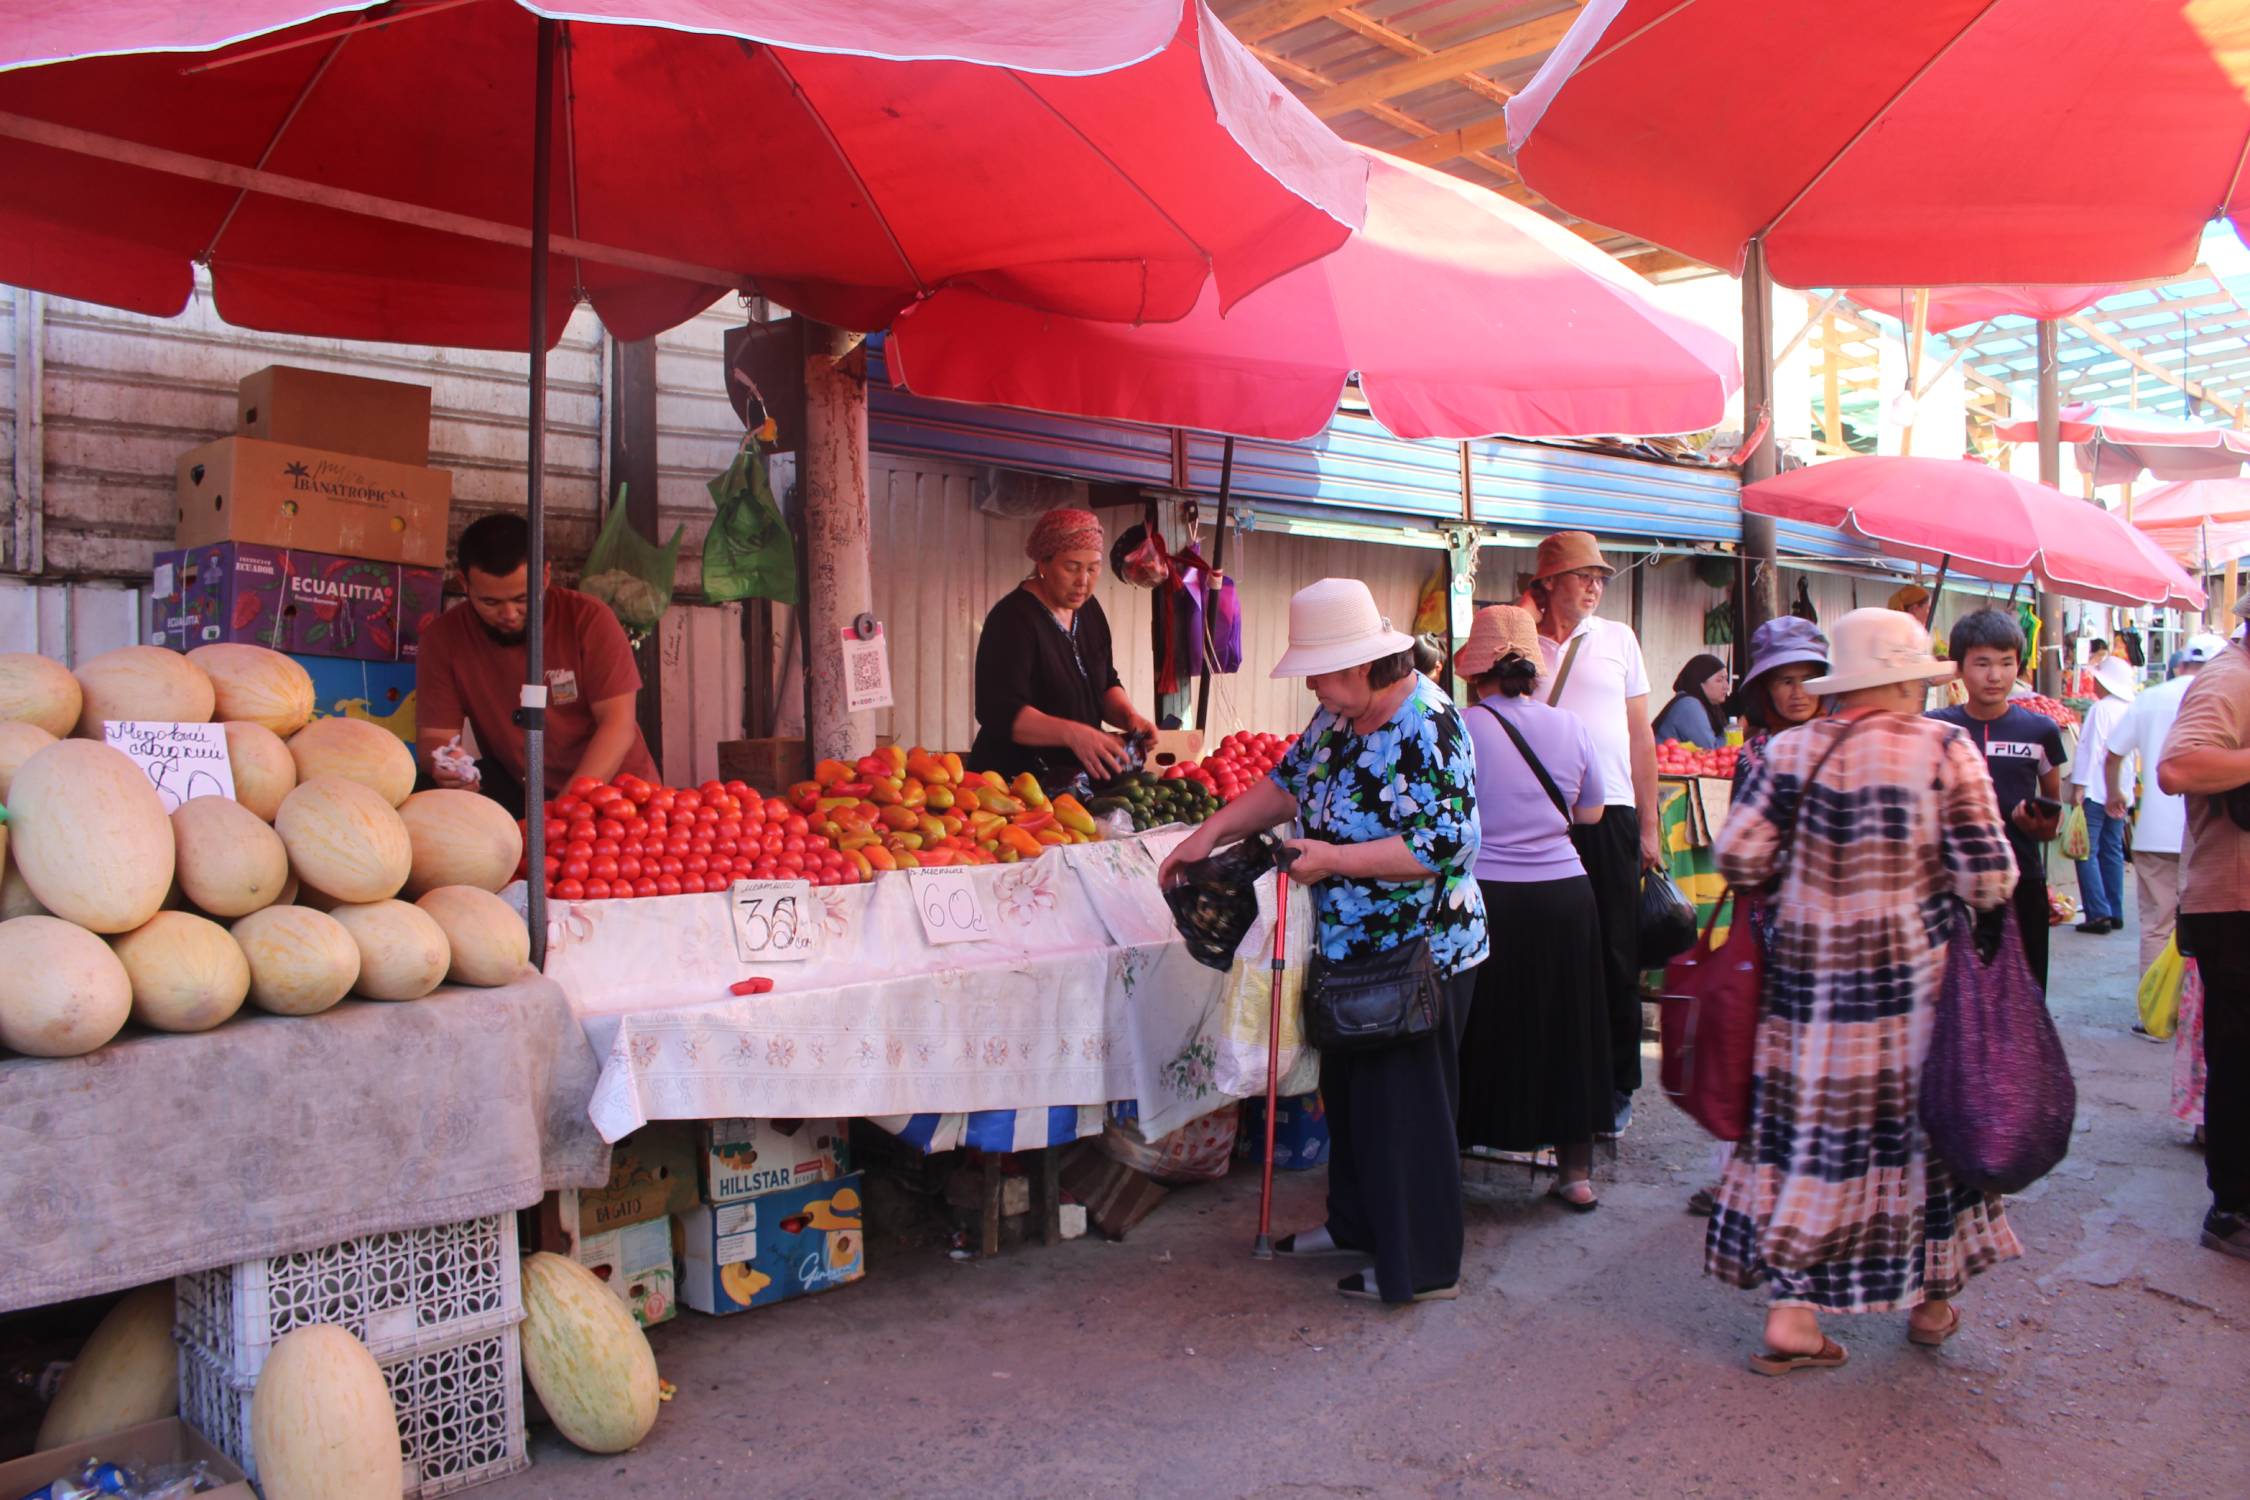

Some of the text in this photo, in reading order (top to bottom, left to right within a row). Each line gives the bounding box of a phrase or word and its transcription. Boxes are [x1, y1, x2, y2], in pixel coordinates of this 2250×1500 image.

[235, 562, 275, 575] ECUADOR
[291, 576, 385, 602] ECUALITTA
[1995, 744, 2032, 757] FILA
[923, 882, 975, 930] 60
[720, 1168, 790, 1197] HILLSTAR
